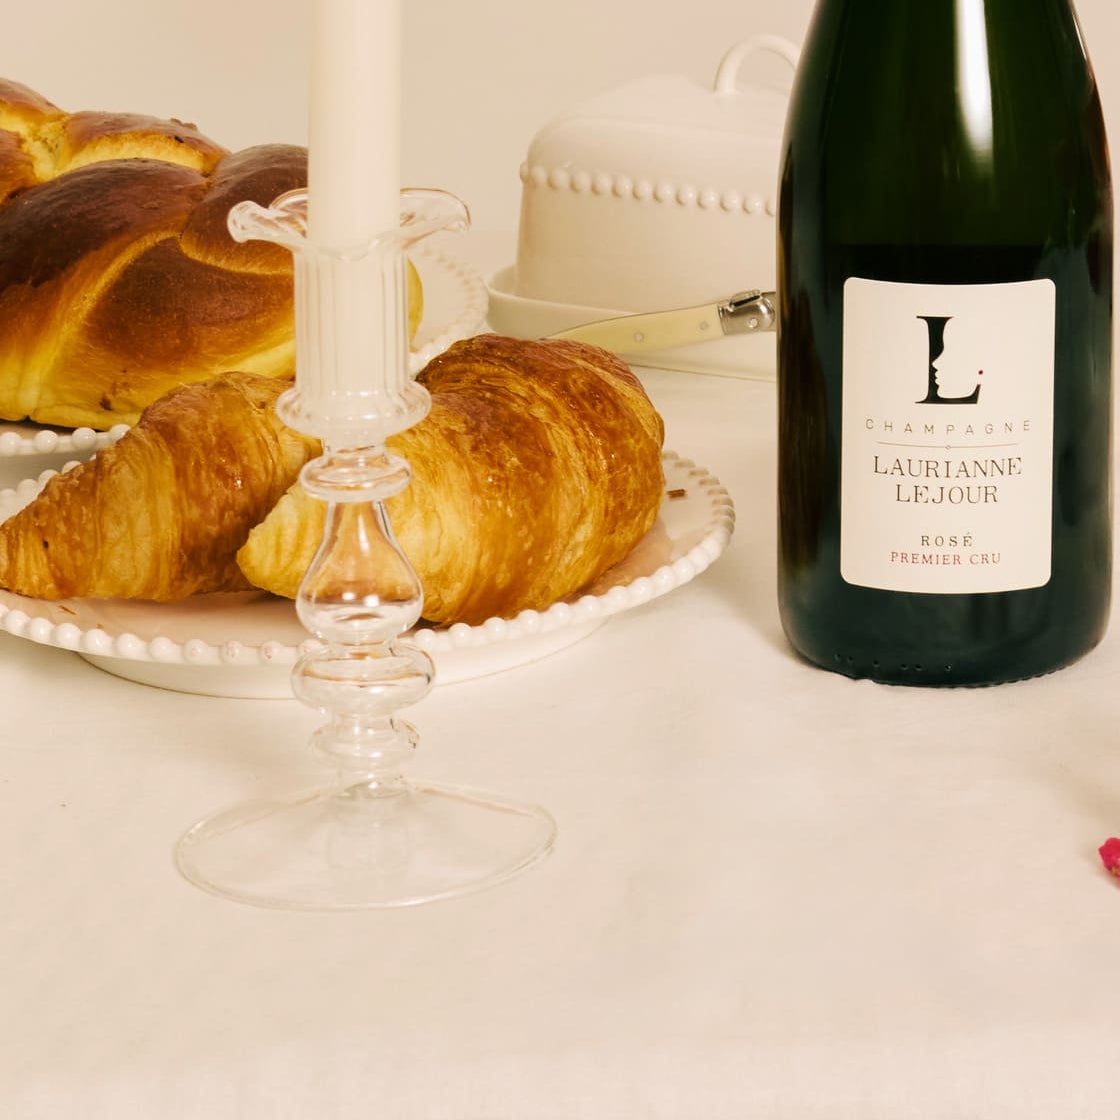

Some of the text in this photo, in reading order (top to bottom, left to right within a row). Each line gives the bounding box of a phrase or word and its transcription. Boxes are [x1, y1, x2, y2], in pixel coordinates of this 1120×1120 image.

[914, 314, 983, 406] L
[865, 417, 1031, 436] CHAMPAGNE
[873, 455, 1023, 479] LAURIANNE
[895, 484, 999, 505] LEJOUR
[920, 532, 974, 548] ROSÉ
[889, 551, 1001, 566] PREMIER CRU
